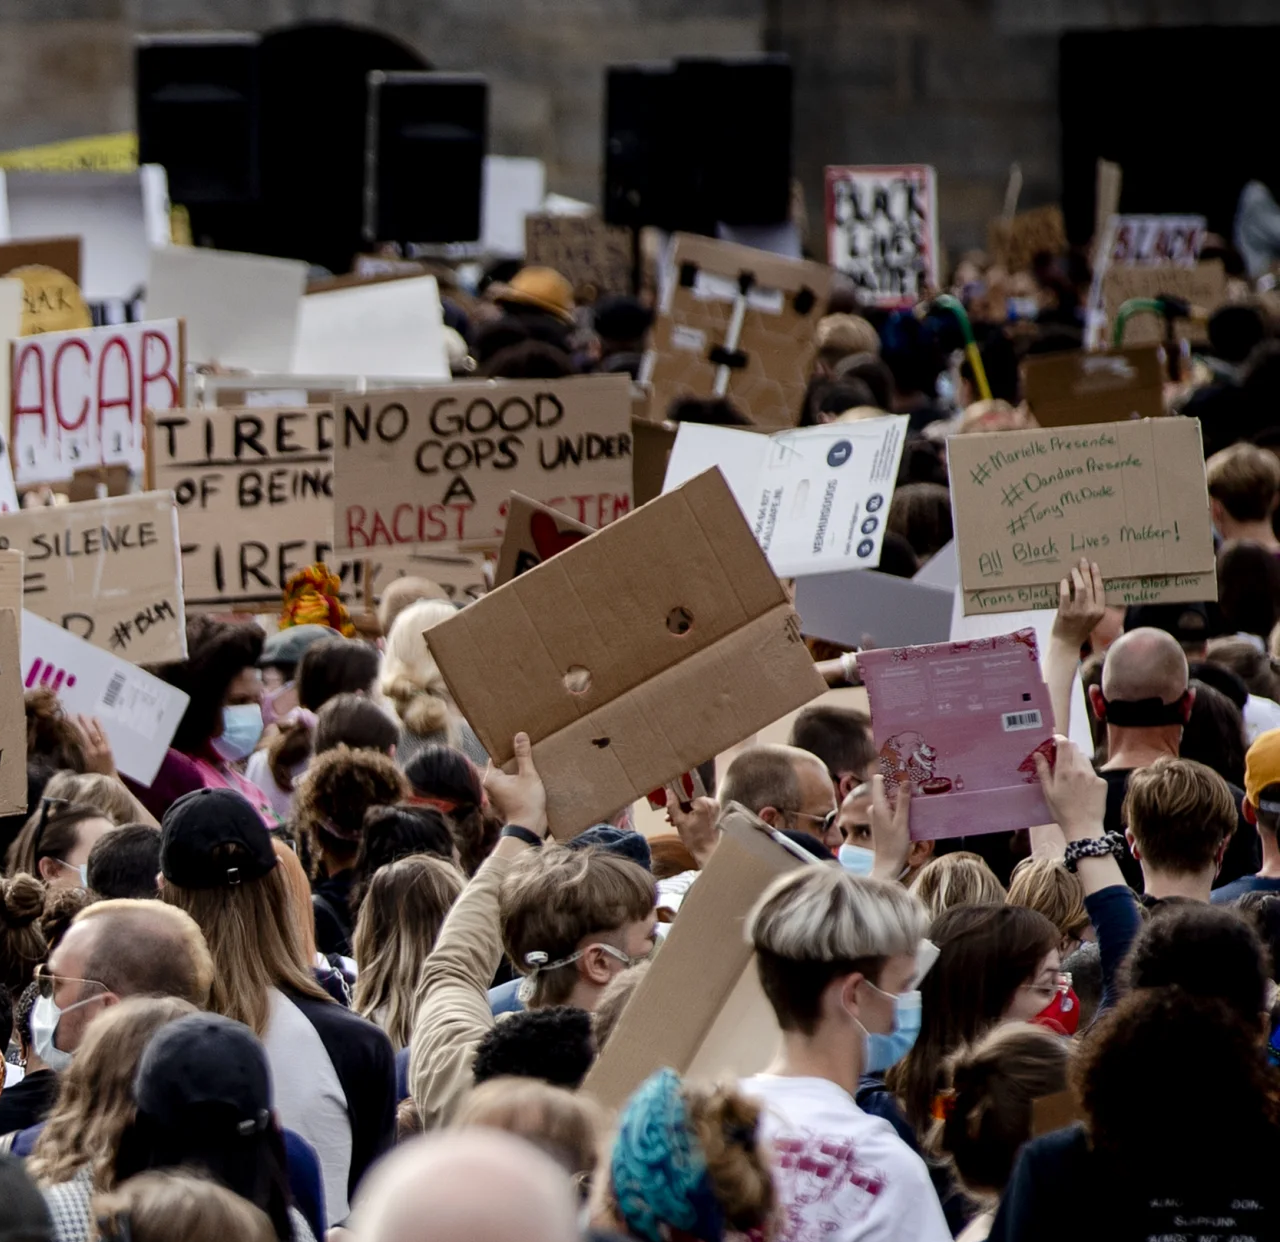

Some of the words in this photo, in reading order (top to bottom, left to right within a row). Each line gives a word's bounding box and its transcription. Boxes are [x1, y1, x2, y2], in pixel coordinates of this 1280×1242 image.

[342, 402, 410, 449] NO
[429, 392, 565, 437] GOOD
[414, 433, 526, 474] COPS
[538, 432, 632, 471] UNDER
[174, 473, 224, 508] OF
[443, 474, 477, 505] A
[28, 521, 159, 561] SILENCE
[346, 502, 475, 549] RACIST
[978, 550, 1005, 574] All
[1012, 536, 1061, 563] Black
[1069, 532, 1111, 553] Lives
[969, 589, 1015, 609] Trans
